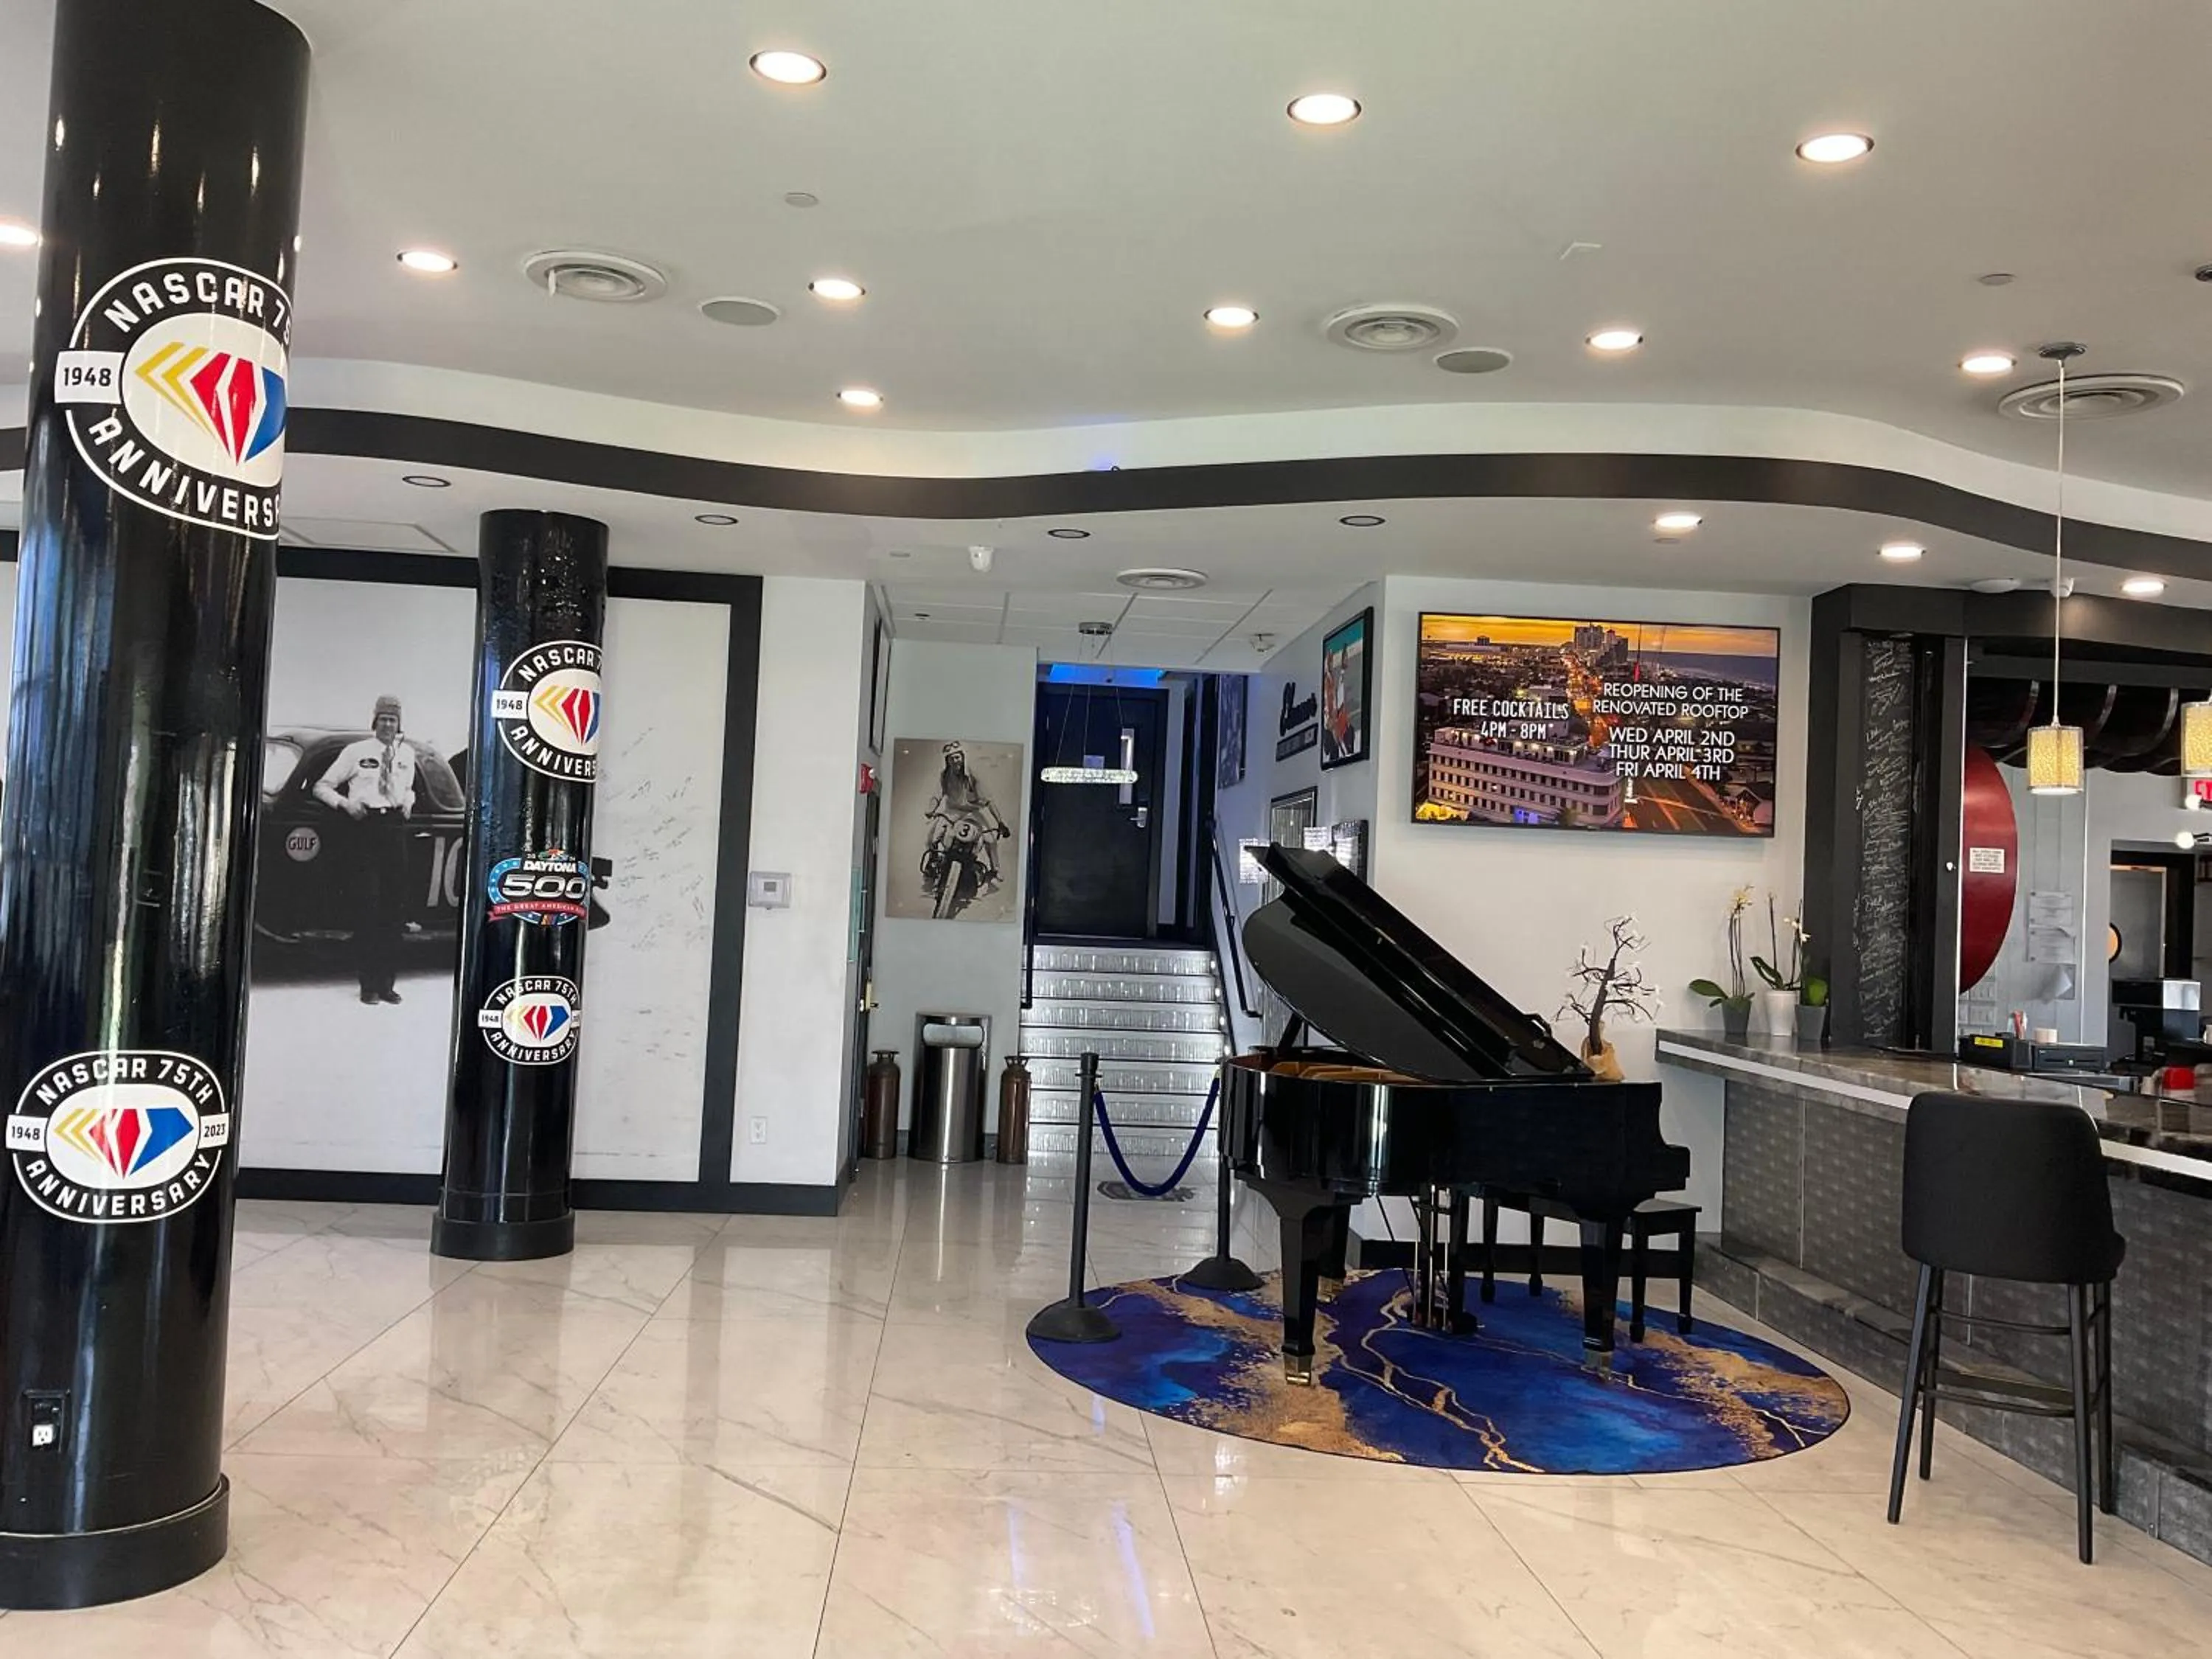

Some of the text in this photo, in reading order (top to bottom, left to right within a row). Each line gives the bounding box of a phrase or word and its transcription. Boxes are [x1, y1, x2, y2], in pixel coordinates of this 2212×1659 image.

[104, 271, 263, 333] NASCAR
[63, 367, 112, 387] 1948
[88, 417, 279, 527] ANNIVERS
[518, 647, 594, 682] NASCAR
[1604, 682, 1744, 702] REOPENING OF THE
[496, 698, 524, 710] 1948
[1453, 698, 1570, 720] FREE COCKTAILS
[1593, 700, 1749, 719] RENOVATED ROOFTOP
[1481, 720, 1506, 738] 4PM
[1520, 723, 1546, 740] 8PM
[1608, 726, 1735, 747] WED APRIL 2ND
[1609, 743, 1735, 763] THUR APRIL 3RD
[1615, 762, 1721, 781] FRI APRIL 4TH
[959, 824, 970, 838] 3
[288, 837, 318, 850] GULF
[523, 860, 577, 873] DAYTONA
[502, 874, 586, 899] 500
[495, 980, 577, 1005] NASCAR 75TH
[490, 1031, 577, 1061] ANNIVERSARY
[37, 1058, 213, 1105] NASCAR 75TH
[11, 1126, 41, 1141] 1948
[204, 1123, 226, 1138] 2023
[27, 1154, 211, 1217] ANNIVERSARY
